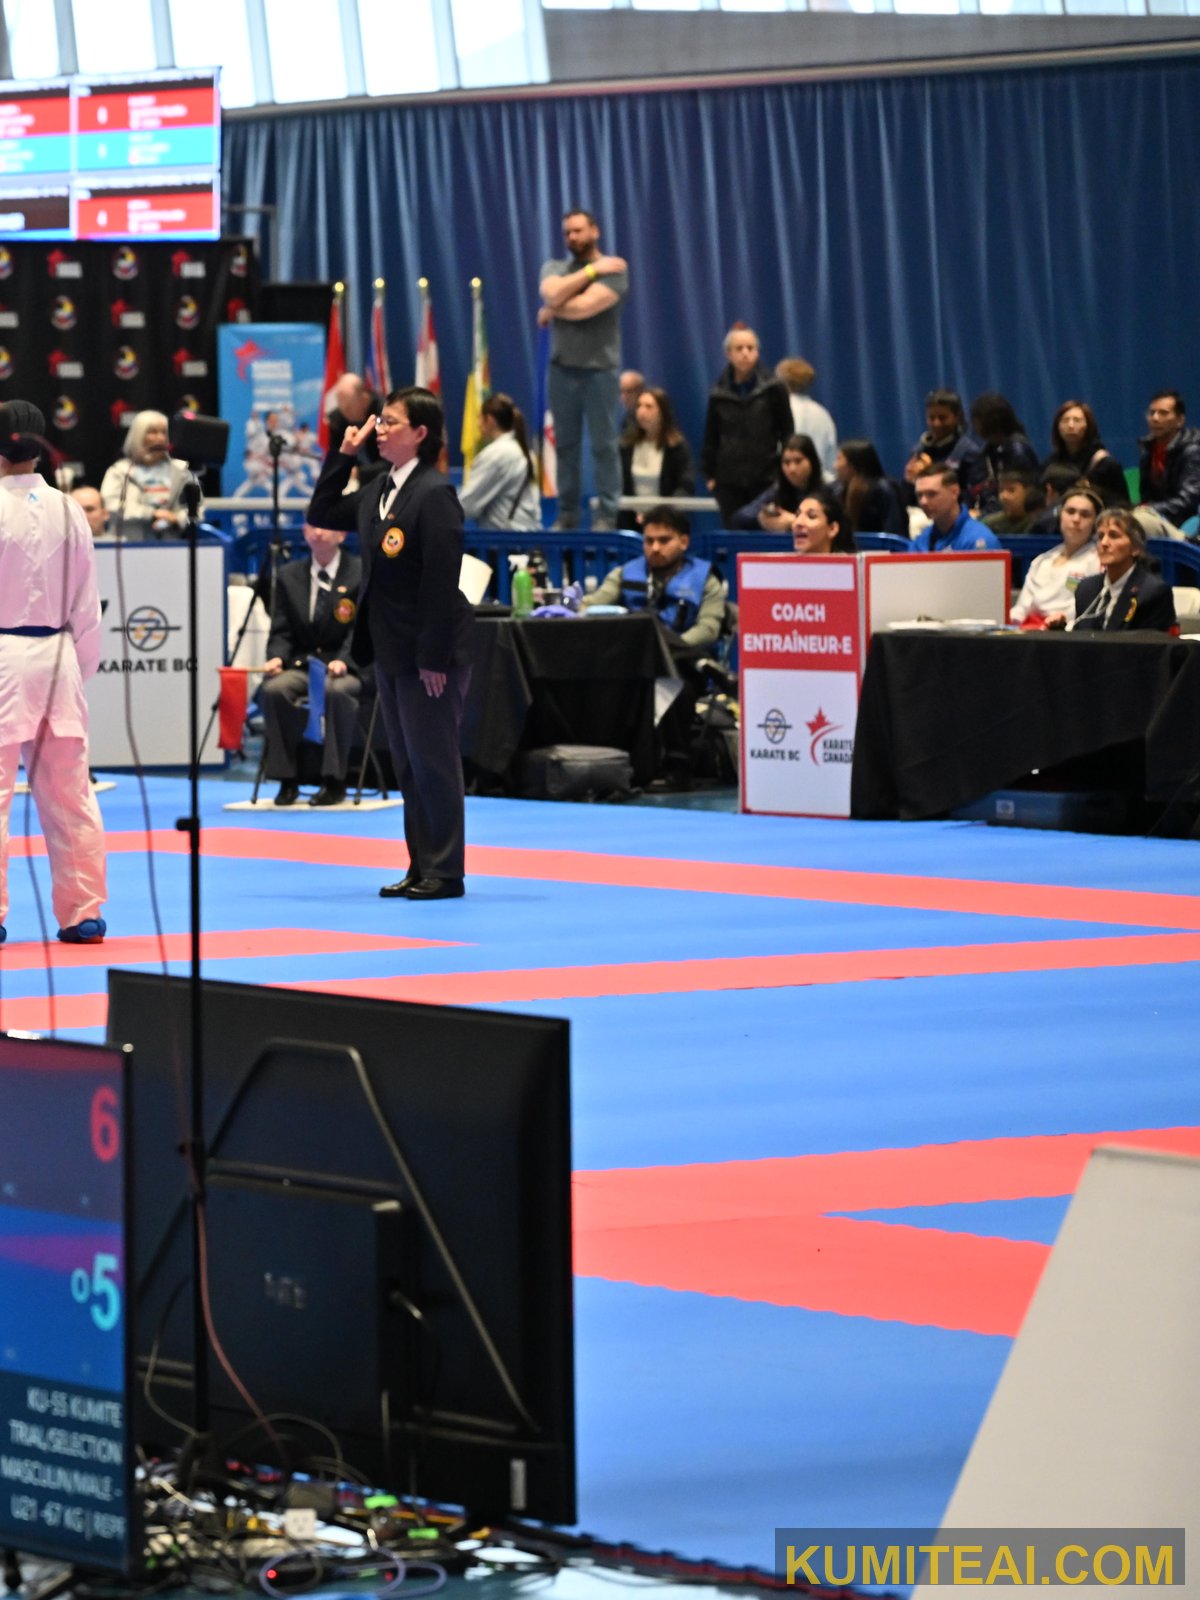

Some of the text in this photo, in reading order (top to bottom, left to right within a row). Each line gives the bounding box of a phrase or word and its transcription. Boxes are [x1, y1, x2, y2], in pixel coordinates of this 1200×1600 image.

[771, 603, 826, 622] COACH
[98, 659, 167, 672] KARATE
[750, 749, 800, 761] KARATE BC
[90, 1086, 120, 1162] 6
